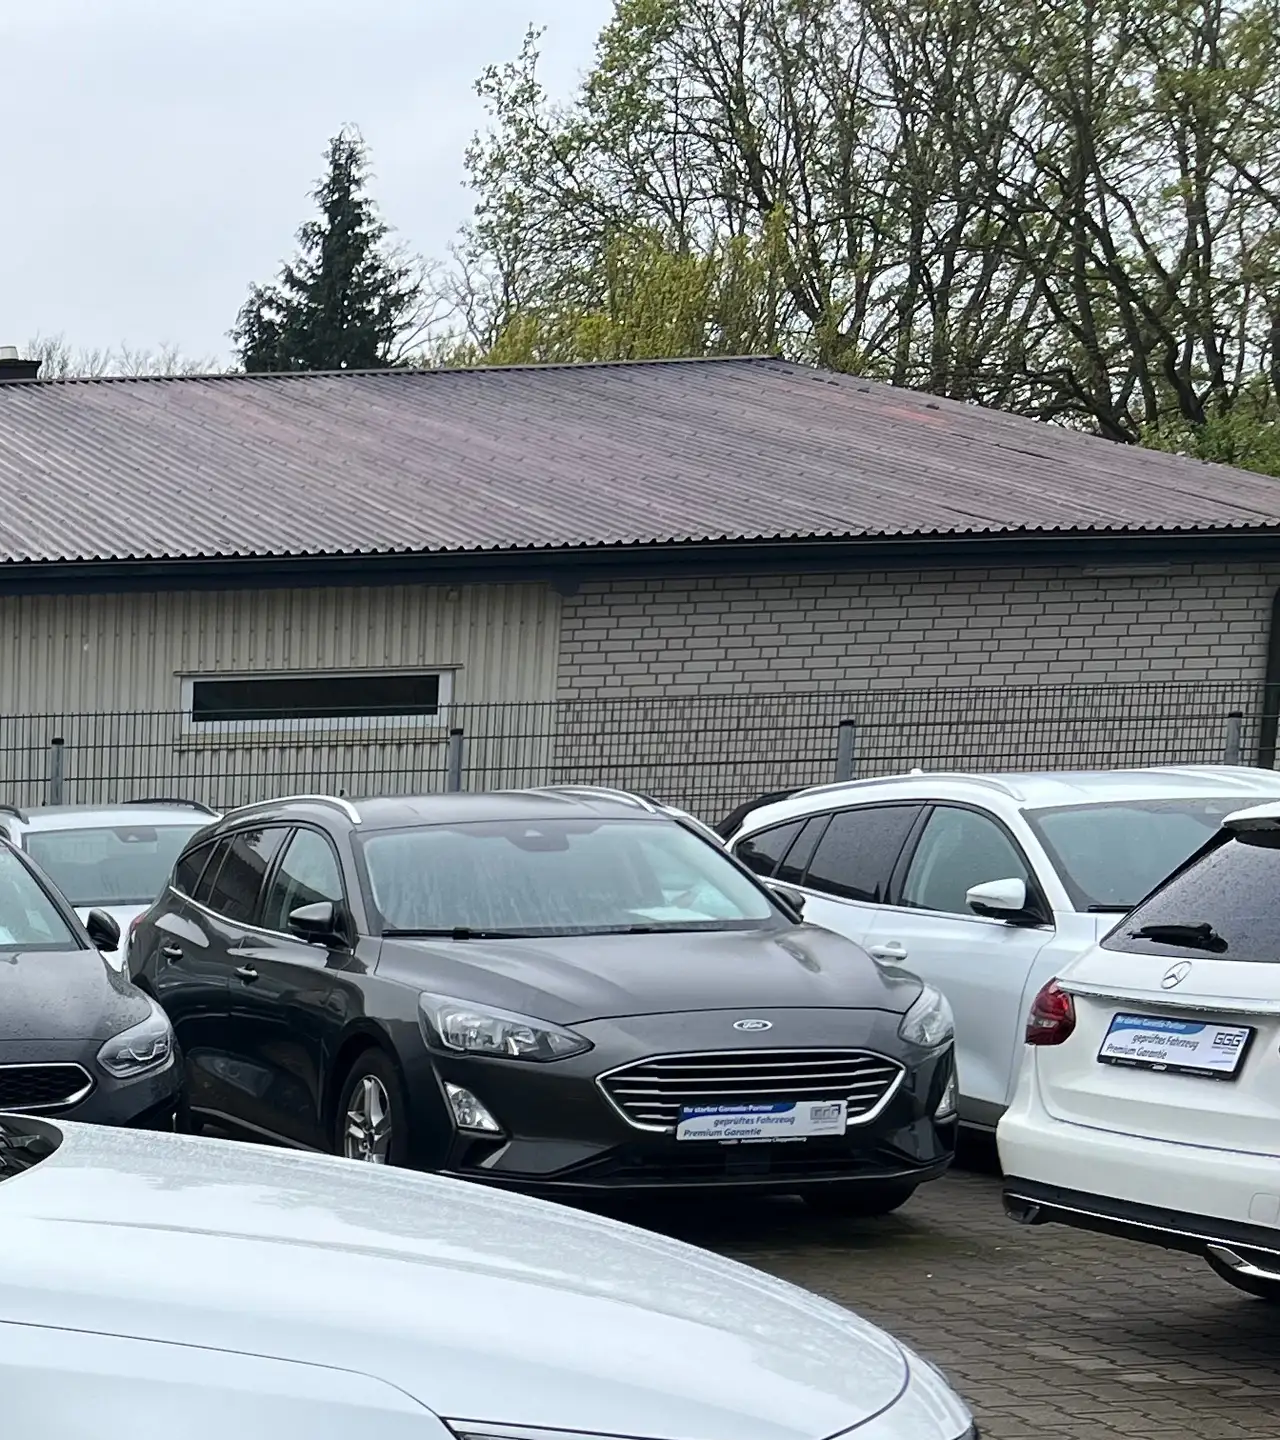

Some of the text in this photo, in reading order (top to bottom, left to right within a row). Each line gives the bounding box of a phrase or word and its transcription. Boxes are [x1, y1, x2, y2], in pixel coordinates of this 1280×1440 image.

[1132, 1033, 1200, 1051] geprüftes Fahrzeug
[1213, 1032, 1243, 1047] GGG
[1106, 1043, 1168, 1060] Premium Garantie
[713, 1116, 796, 1128] geprüftes Fahrzeug
[683, 1127, 762, 1137] Premium Garantie
